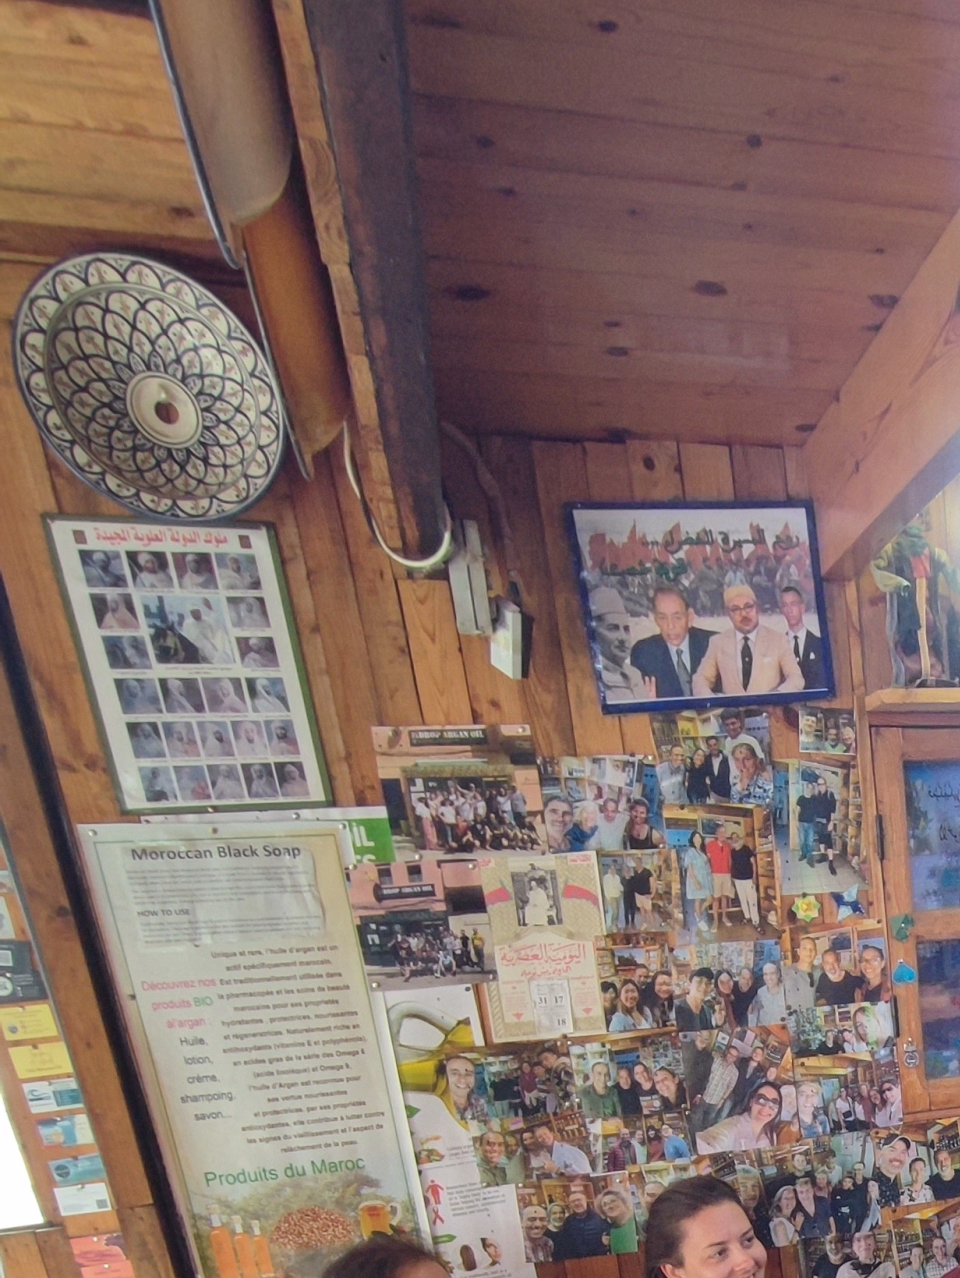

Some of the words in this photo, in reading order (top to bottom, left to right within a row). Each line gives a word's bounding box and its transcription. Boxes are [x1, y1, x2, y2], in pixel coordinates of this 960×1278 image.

[131, 527, 166, 547] العلوية
[170, 528, 200, 547] الدولة
[131, 847, 213, 861] Moroccan
[217, 845, 260, 858] Black
[263, 844, 301, 859] Soap
[161, 909, 172, 917] TO
[174, 908, 190, 916] USE
[141, 978, 195, 991] Découvrez
[198, 978, 217, 987] nos
[152, 998, 192, 1012] produits
[193, 996, 214, 1007] BIO
[538, 996, 547, 1005] 31
[554, 995, 564, 1004] 17
[557, 1018, 567, 1026] 18
[179, 1037, 208, 1047] Huile,
[183, 1055, 214, 1065] lotion,
[180, 1091, 236, 1104] shampoing,
[204, 1166, 279, 1188] Produits
[283, 1162, 307, 1179] du
[311, 1157, 366, 1175] Maroc
